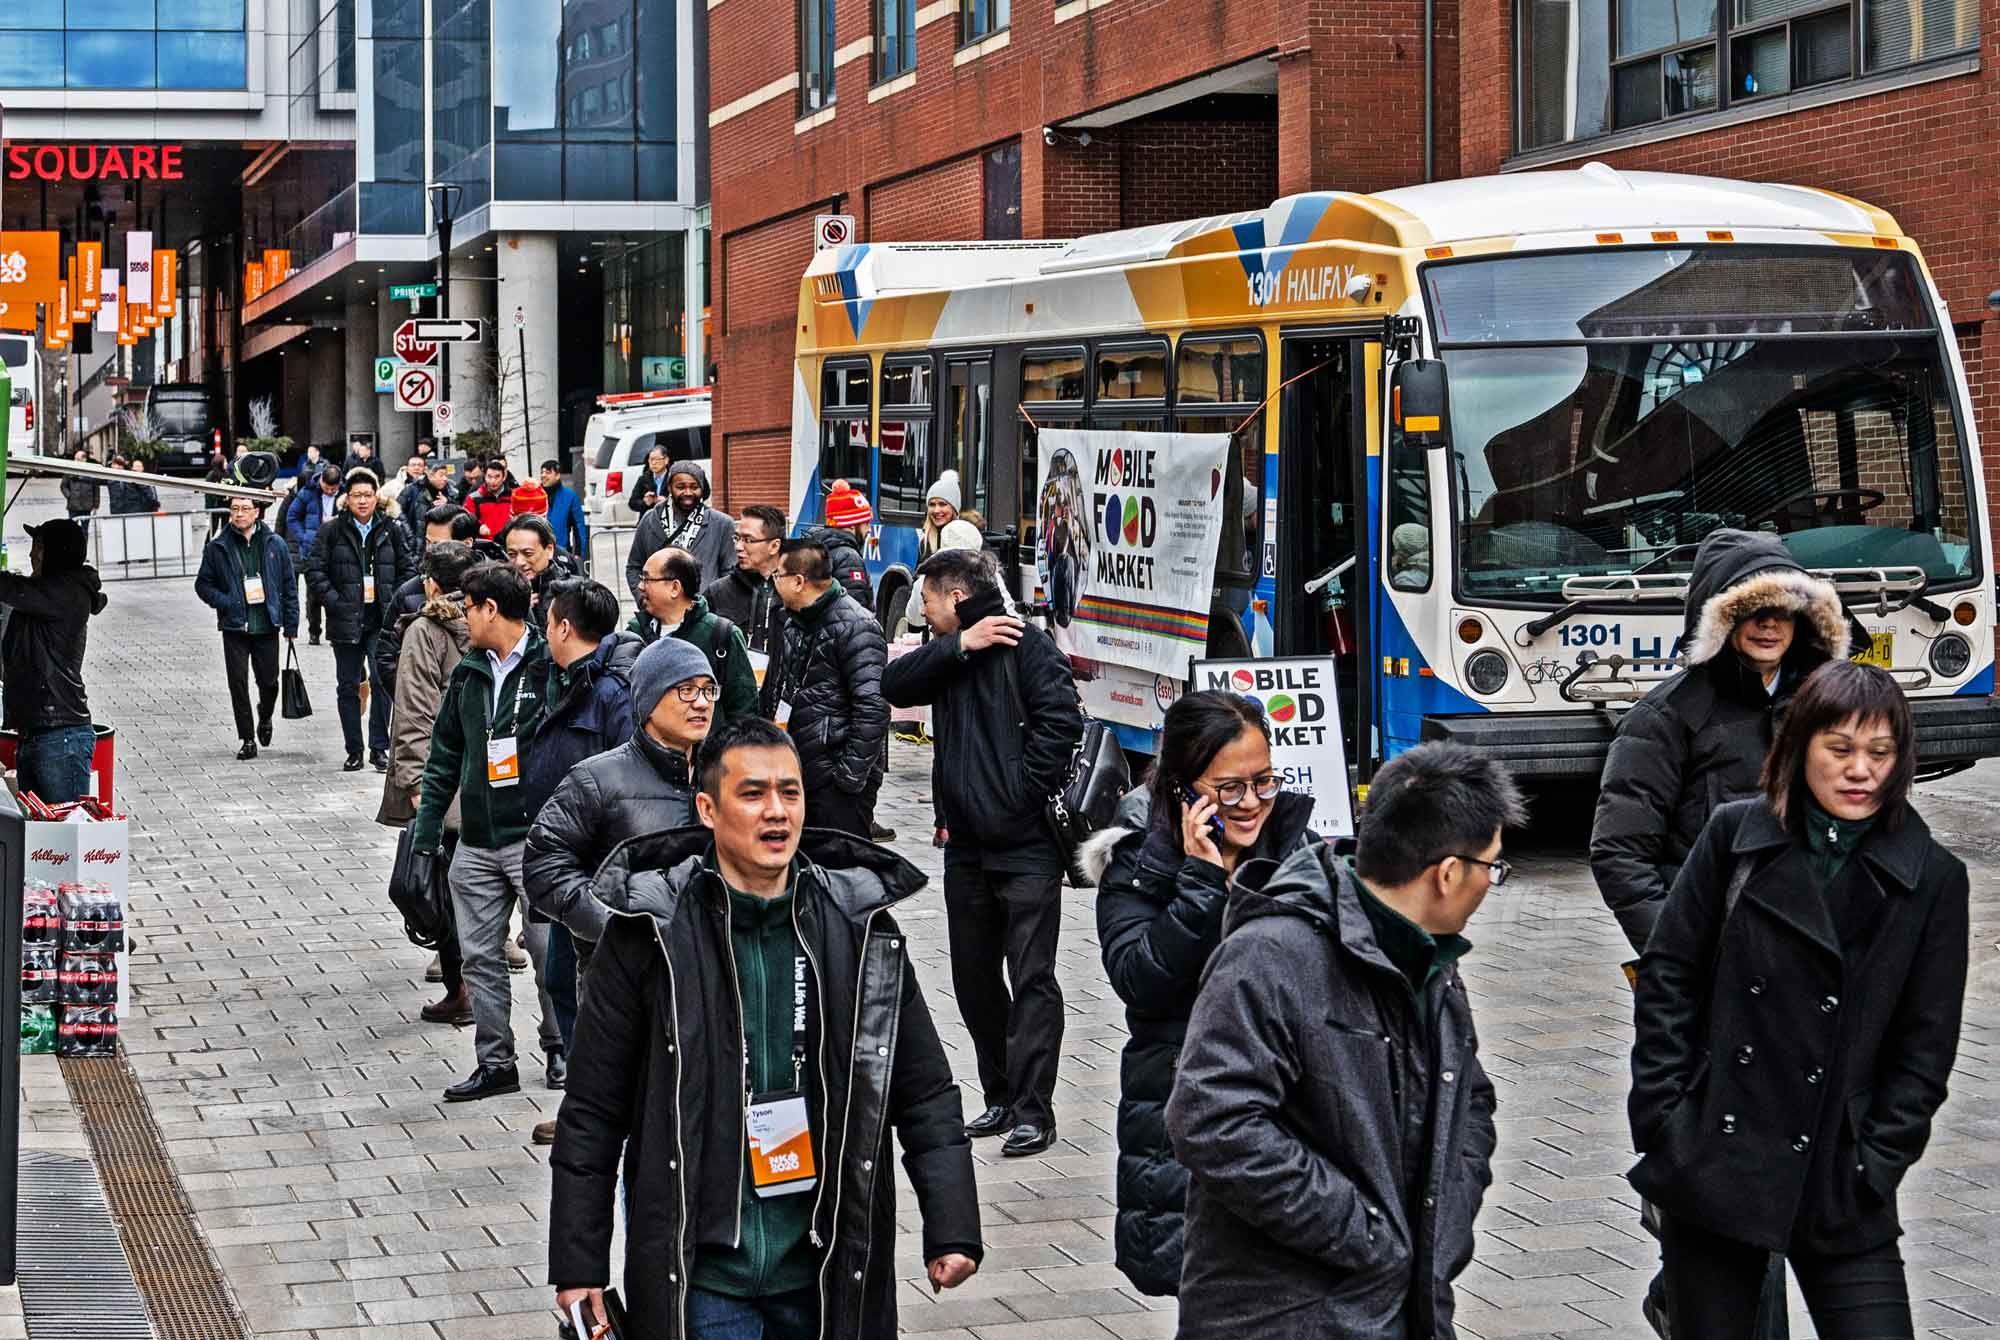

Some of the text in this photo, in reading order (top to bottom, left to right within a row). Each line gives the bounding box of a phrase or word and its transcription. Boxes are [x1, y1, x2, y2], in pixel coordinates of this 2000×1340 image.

[8, 144, 184, 181] SQUARE
[394, 286, 426, 297] PRINCE
[1248, 264, 1355, 306] 1301 HALIFAX
[1095, 448, 1156, 488] MOBILE
[1093, 493, 1156, 548] FOOD
[1096, 550, 1154, 590] MARKET
[1558, 623, 1621, 646] 1301
[1208, 667, 1321, 692] MOBILE
[31, 848, 70, 865] Kellogg's
[84, 848, 121, 864] Kellogg's
[752, 1109, 773, 1118] Tyson
